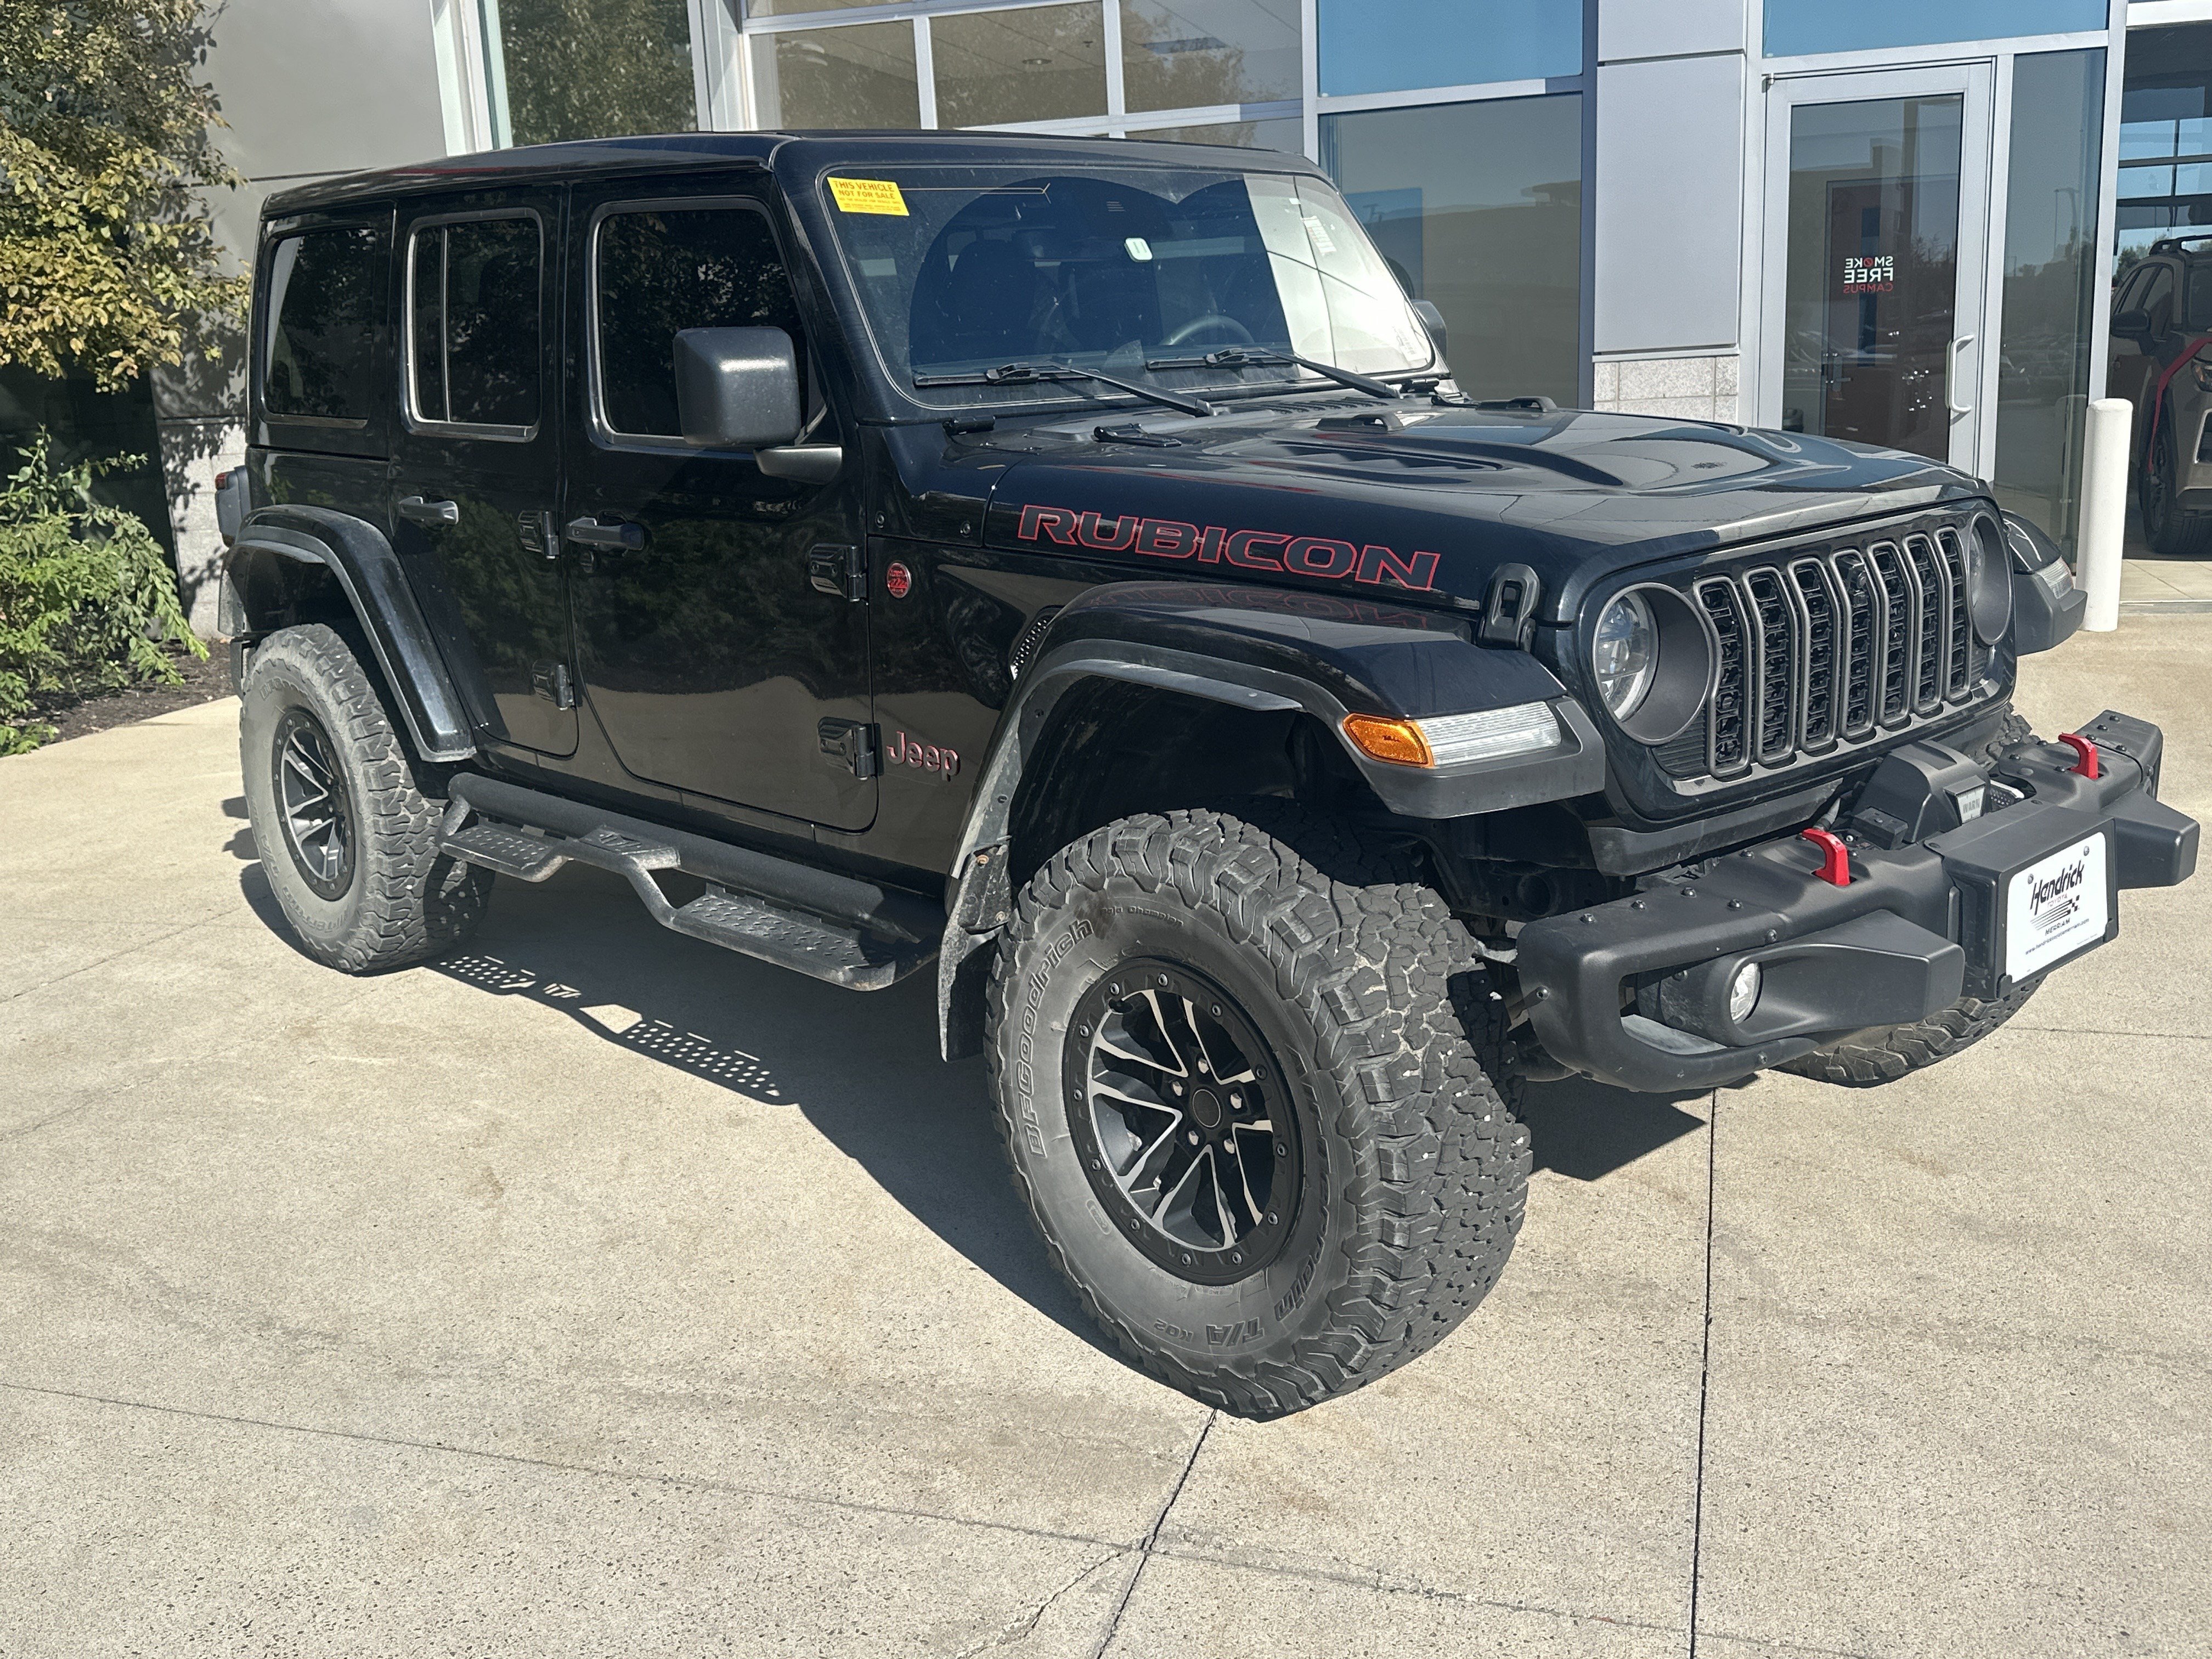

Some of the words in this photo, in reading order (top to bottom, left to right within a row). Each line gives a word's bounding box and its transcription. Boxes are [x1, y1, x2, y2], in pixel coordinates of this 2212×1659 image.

[833, 180, 855, 189] THIS
[856, 182, 894, 192] VEHICLE
[1018, 505, 1440, 591] RUBICON
[887, 731, 961, 782] Jeep
[1962, 798, 1980, 814] WARN
[2029, 859, 2085, 916] Hendrick
[1127, 905, 1184, 929] Champion
[1017, 919, 1093, 1158] BFGoodrich
[1206, 1317, 1265, 1346] T/A
